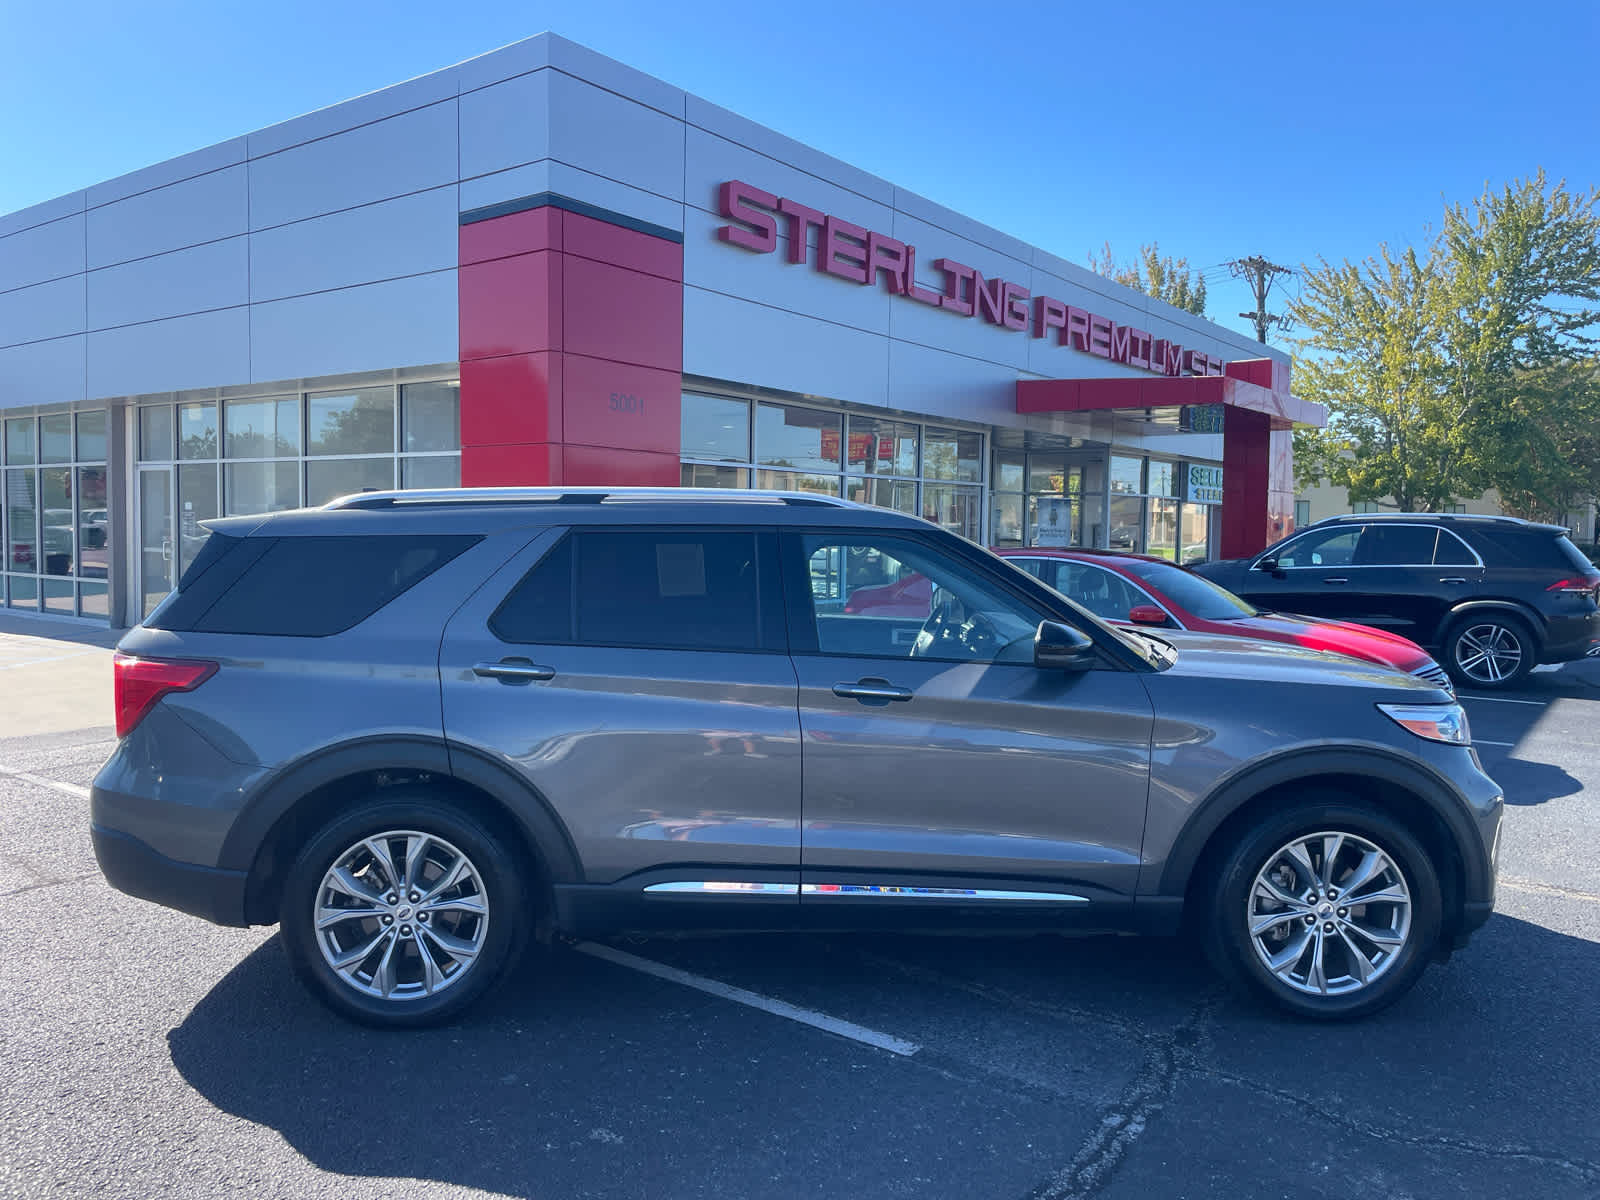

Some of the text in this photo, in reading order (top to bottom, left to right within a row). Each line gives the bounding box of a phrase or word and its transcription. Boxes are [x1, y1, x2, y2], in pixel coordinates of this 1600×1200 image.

[718, 179, 1030, 331] STERLING
[1032, 296, 1184, 377] PREMIUM
[608, 392, 645, 416] 5001
